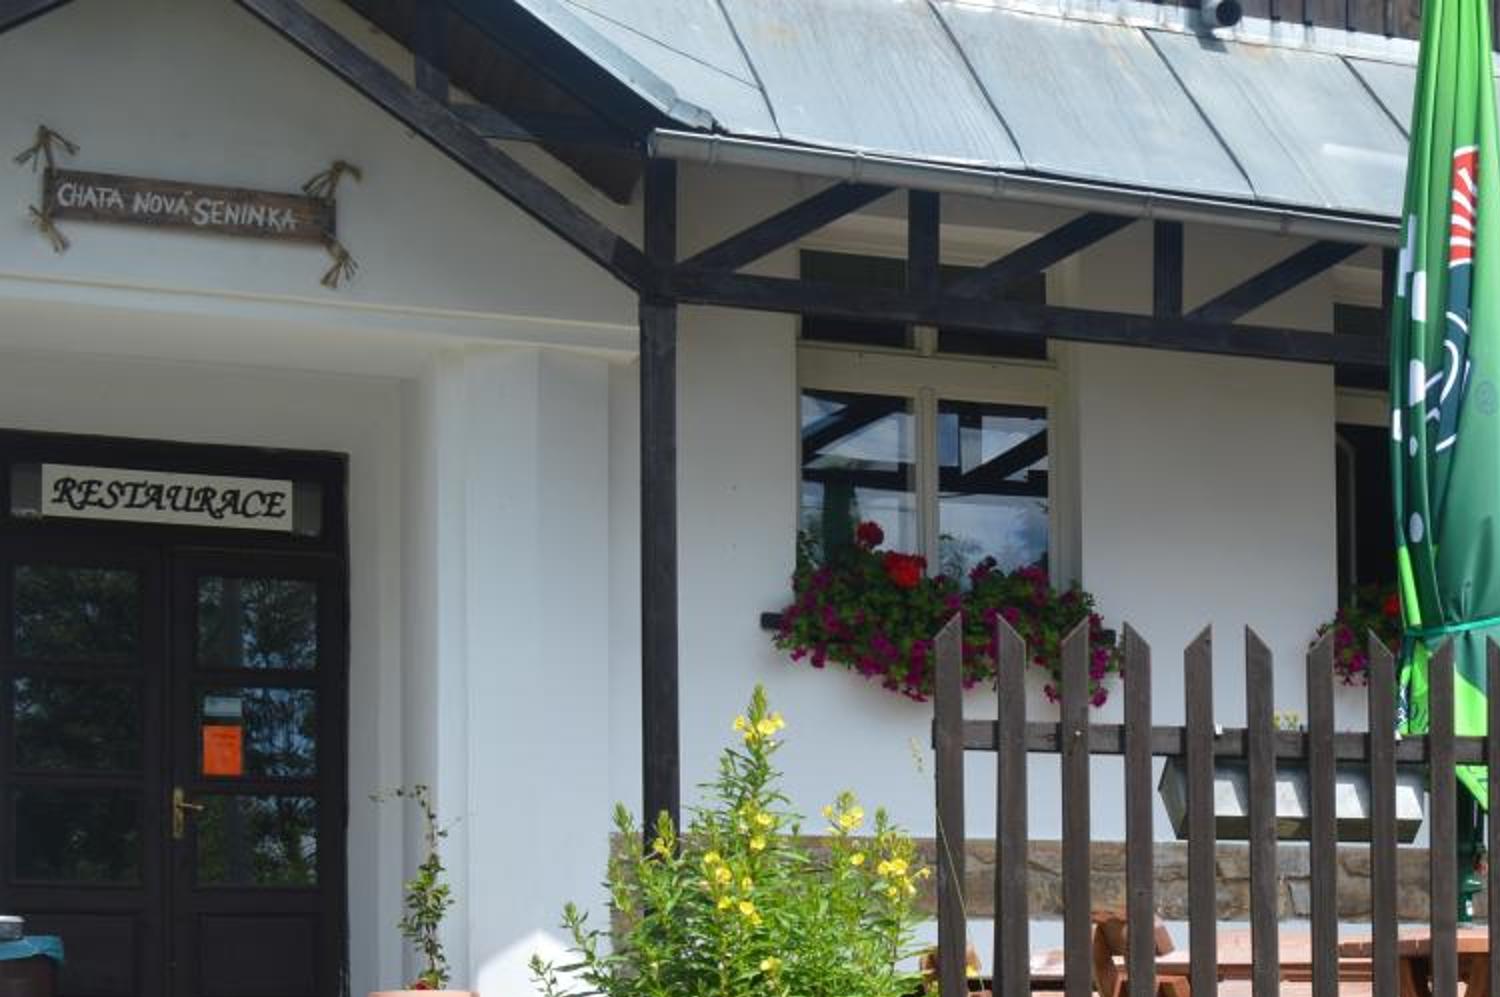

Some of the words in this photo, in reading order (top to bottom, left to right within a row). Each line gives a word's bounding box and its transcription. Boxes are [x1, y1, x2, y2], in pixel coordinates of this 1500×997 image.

[57, 182, 125, 210] CHATA
[132, 190, 190, 216] NOVÁ
[191, 198, 298, 231] SENINKA
[52, 477, 287, 520] RESTAURACE
